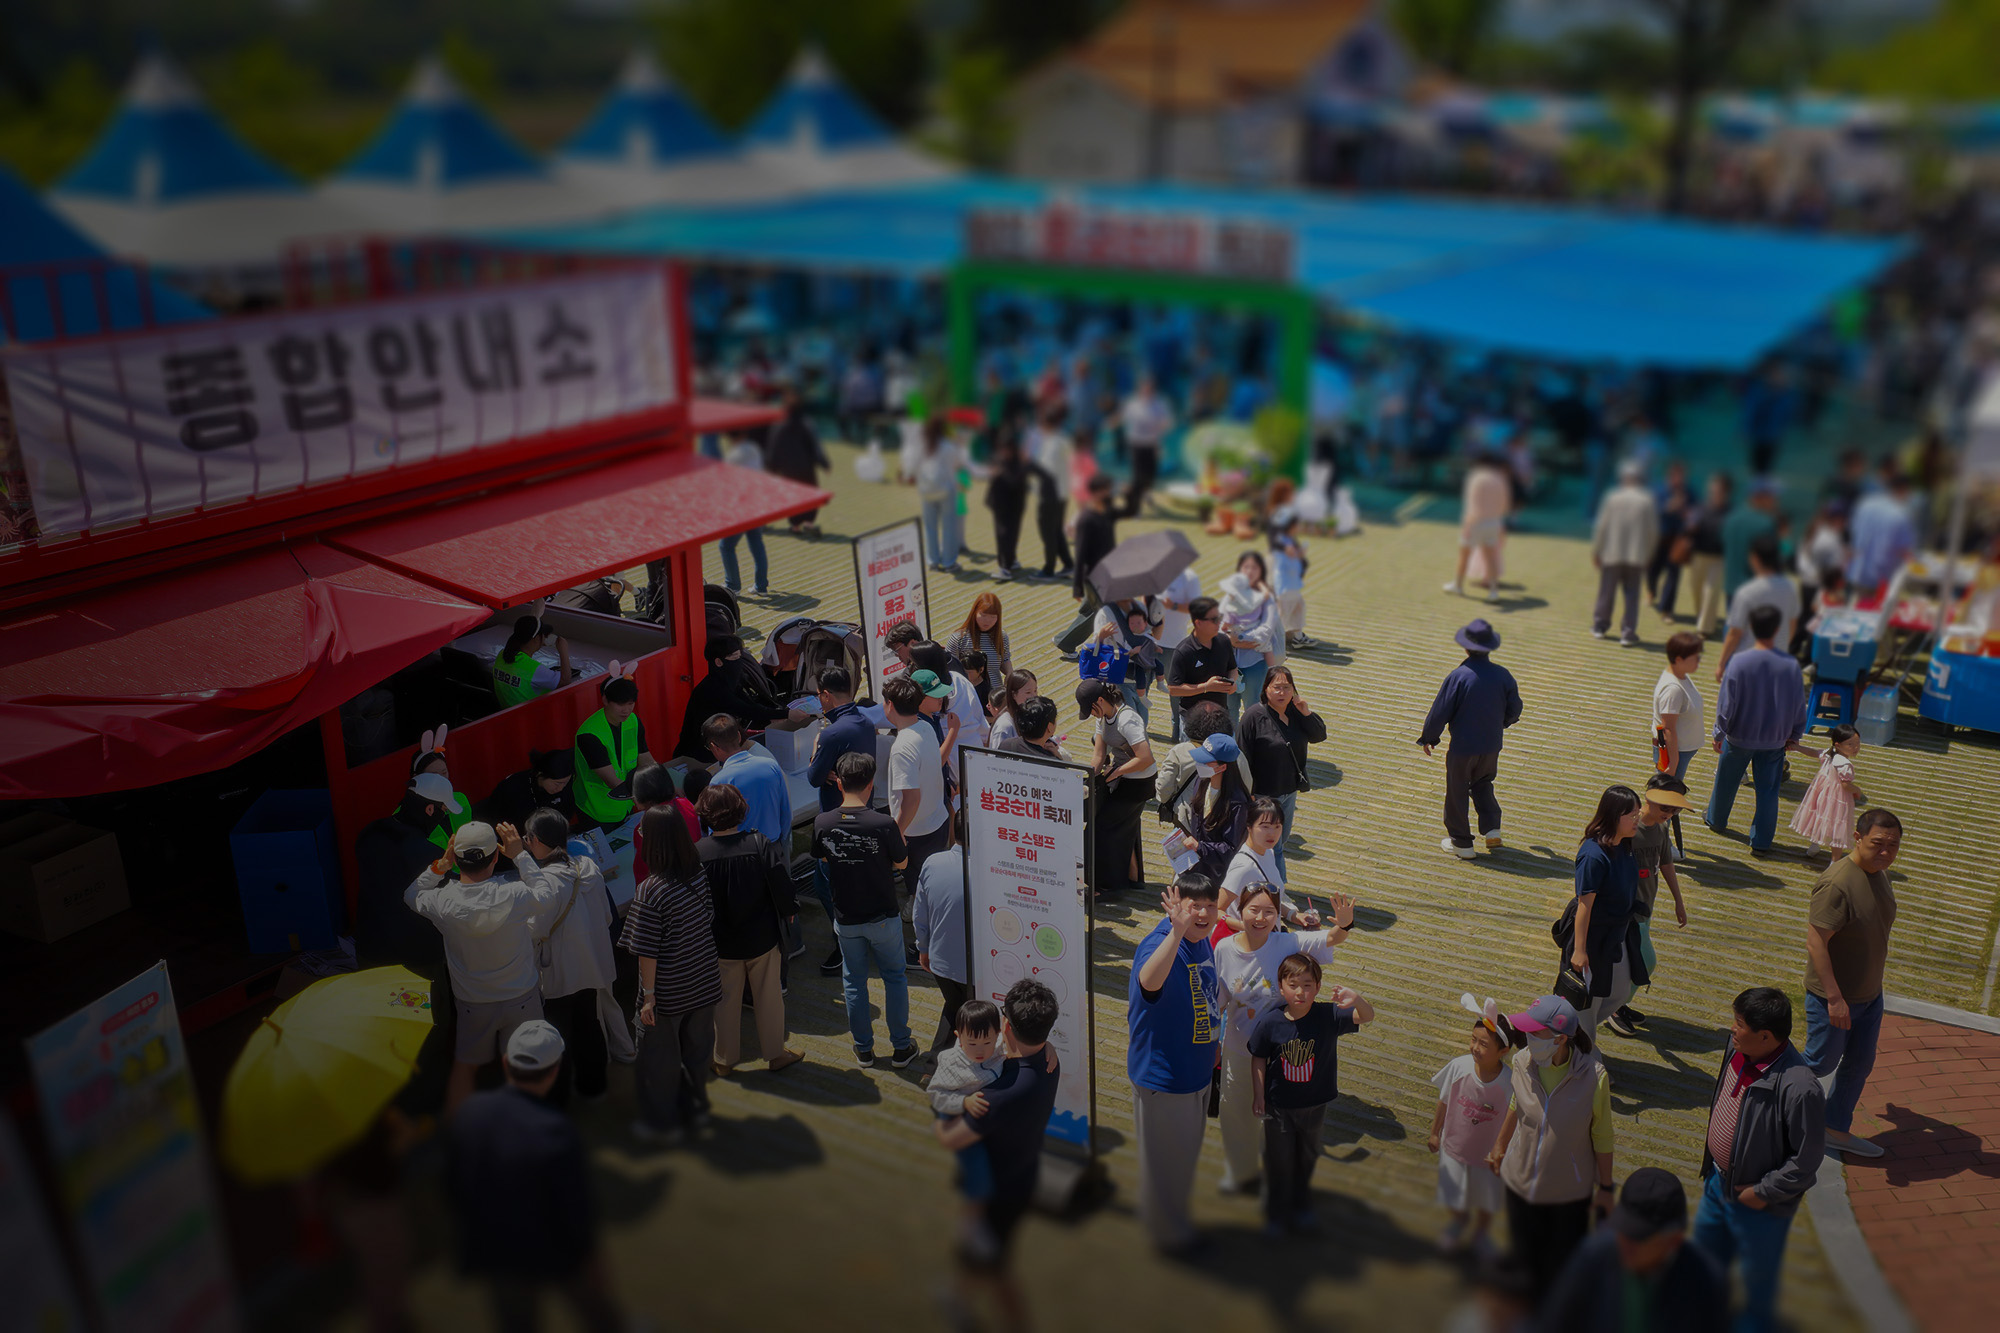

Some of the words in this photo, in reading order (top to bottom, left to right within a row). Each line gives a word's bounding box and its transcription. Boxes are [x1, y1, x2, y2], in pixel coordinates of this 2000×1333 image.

[161, 300, 597, 452] 종합안내소
[885, 595, 905, 616] 용궁
[997, 781, 1028, 798] 2026
[1031, 787, 1053, 802] 예천
[980, 788, 1041, 820] 용궁순대
[1043, 805, 1072, 826] 축제
[998, 827, 1019, 843] 용궁
[1022, 832, 1056, 850] 스탬프
[1015, 847, 1038, 863] 투어
[1195, 1006, 1208, 1018] EX
[1195, 1019, 1210, 1042] DEUS
